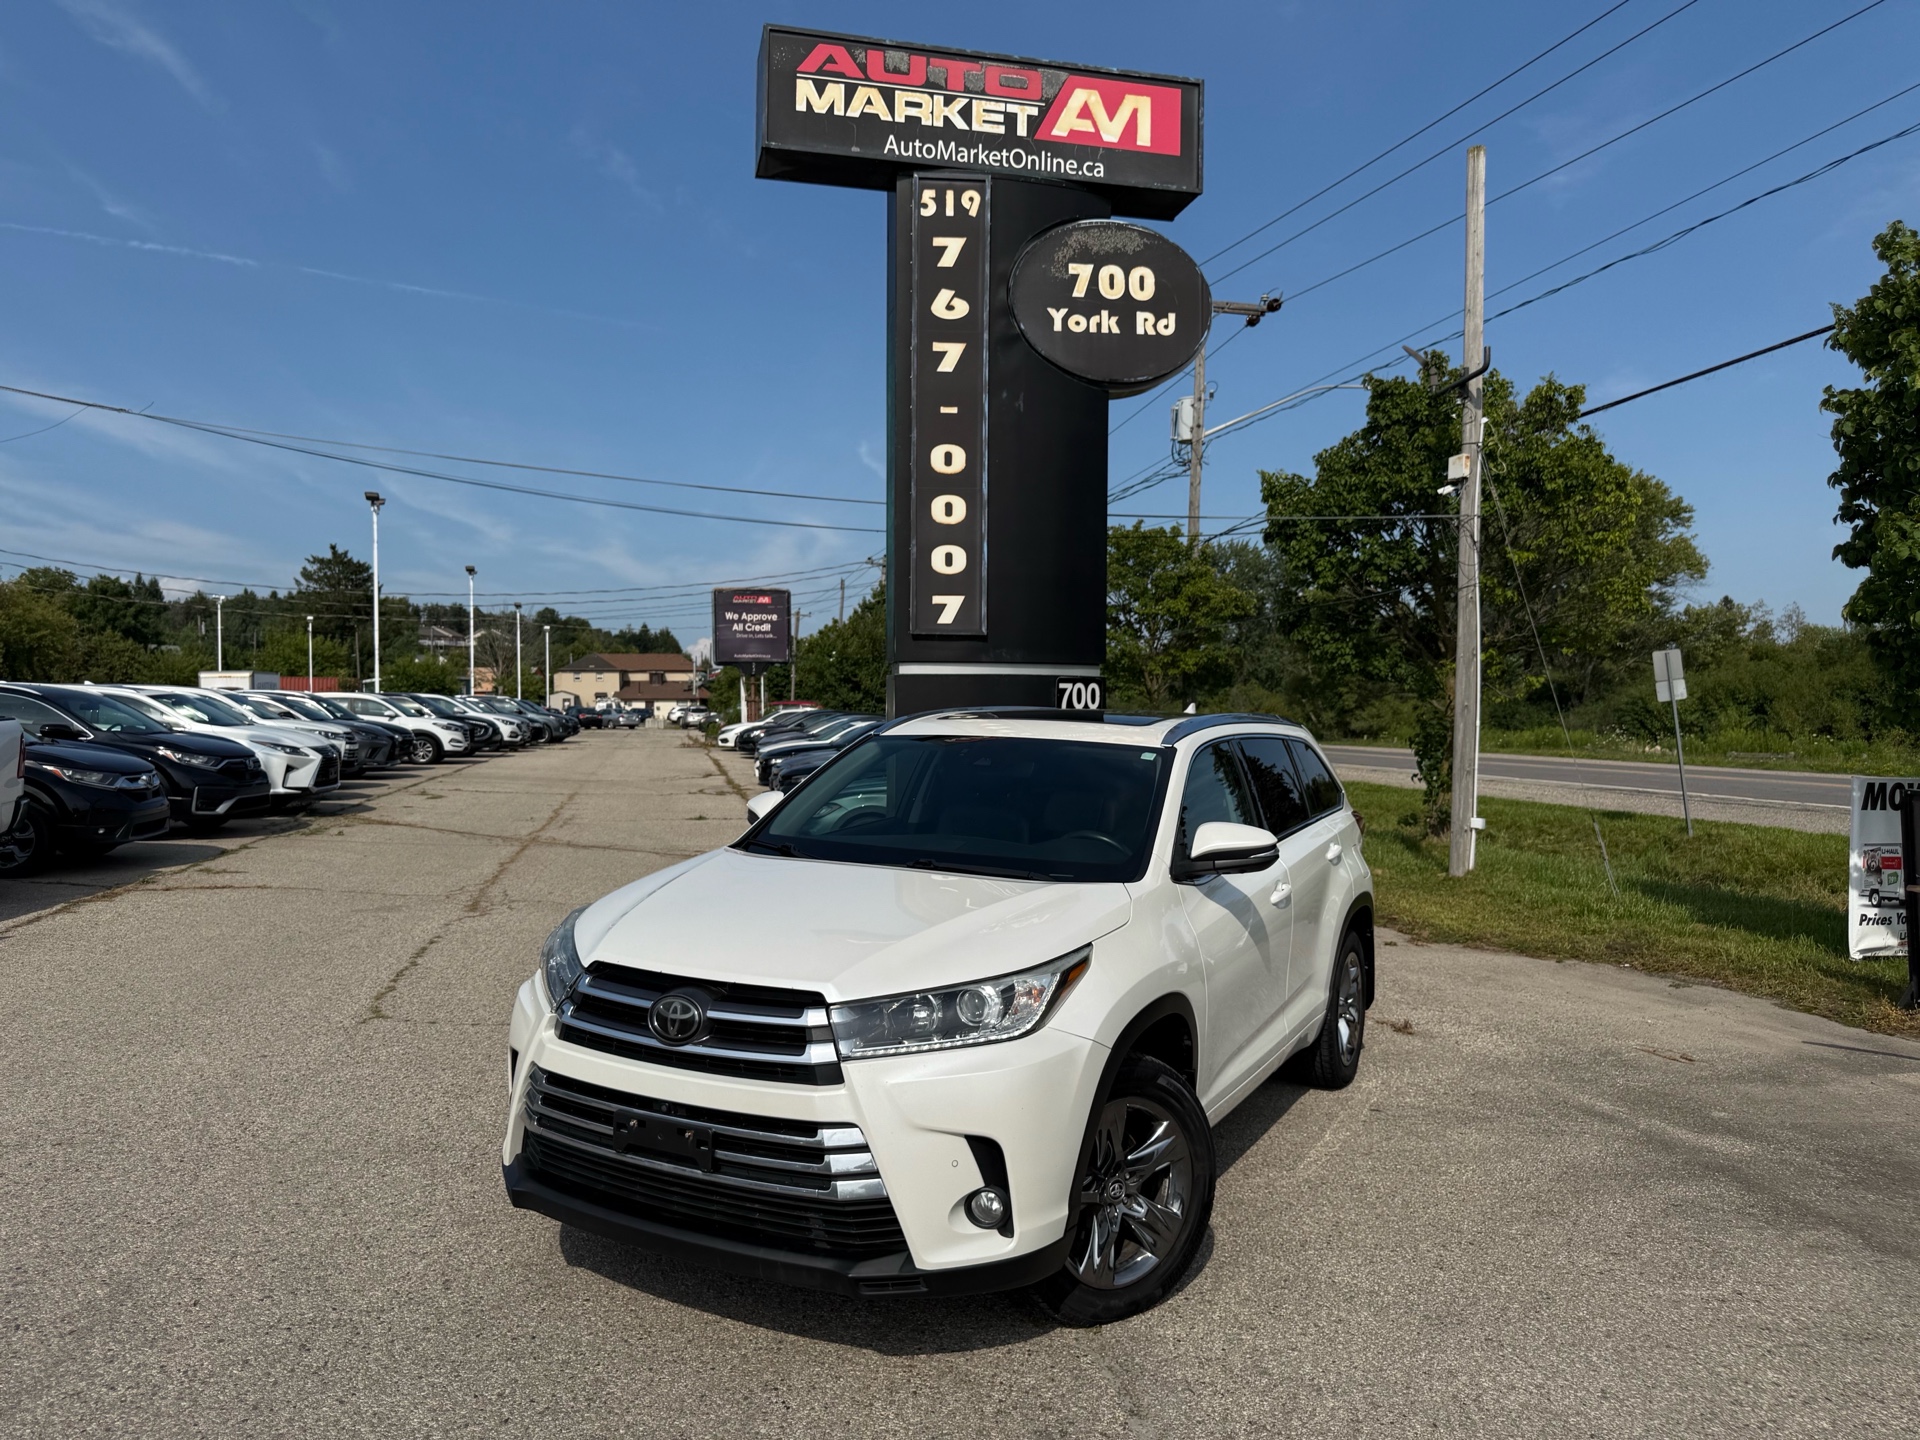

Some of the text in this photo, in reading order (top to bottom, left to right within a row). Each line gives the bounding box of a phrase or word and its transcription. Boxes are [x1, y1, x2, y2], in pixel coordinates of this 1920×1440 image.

[796, 43, 1043, 101] AUTO
[796, 79, 1039, 138] MARKET
[884, 134, 1105, 178] AutoMarketOnline.ca
[920, 189, 981, 218] 519
[1068, 263, 1156, 302] 700
[1046, 307, 1176, 337] York Rd
[725, 611, 778, 622] We Approve
[732, 622, 771, 632] All Credit
[1058, 682, 1100, 710] 700
[1859, 913, 1893, 926] Prices
